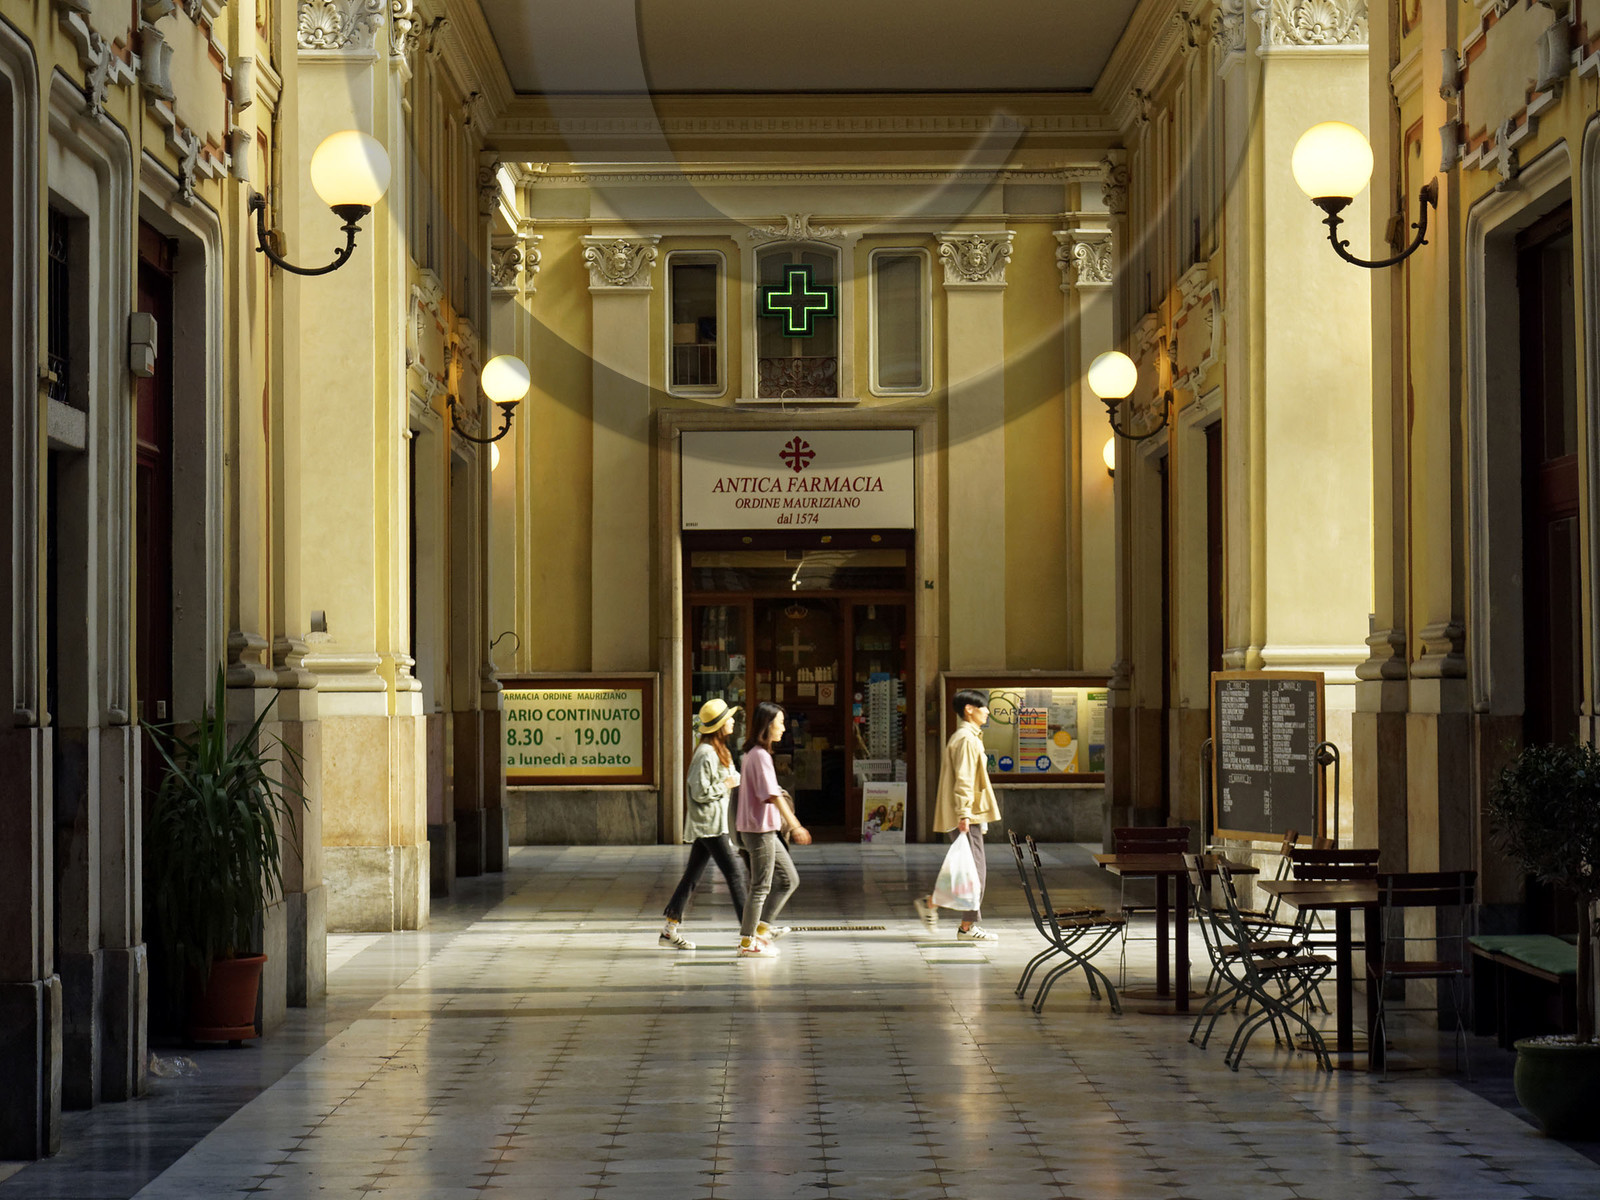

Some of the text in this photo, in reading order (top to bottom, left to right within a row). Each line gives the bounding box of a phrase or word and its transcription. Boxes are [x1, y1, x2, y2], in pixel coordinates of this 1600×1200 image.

[712, 476, 884, 493] ANTICA FARMACIA
[735, 497, 861, 509] ORDINE MAURIZIANO
[777, 513, 819, 525] dal 1574
[542, 692, 572, 700] ORDINE
[577, 692, 627, 700] MAURIZIANO
[507, 708, 640, 721] ARIO CONTINUATO
[993, 708, 1039, 716] FARMA
[1008, 716, 1038, 725] UNIT
[507, 728, 544, 746] 8.30
[574, 728, 621, 745] 19.00
[507, 752, 631, 765] a lunedì a sabato
